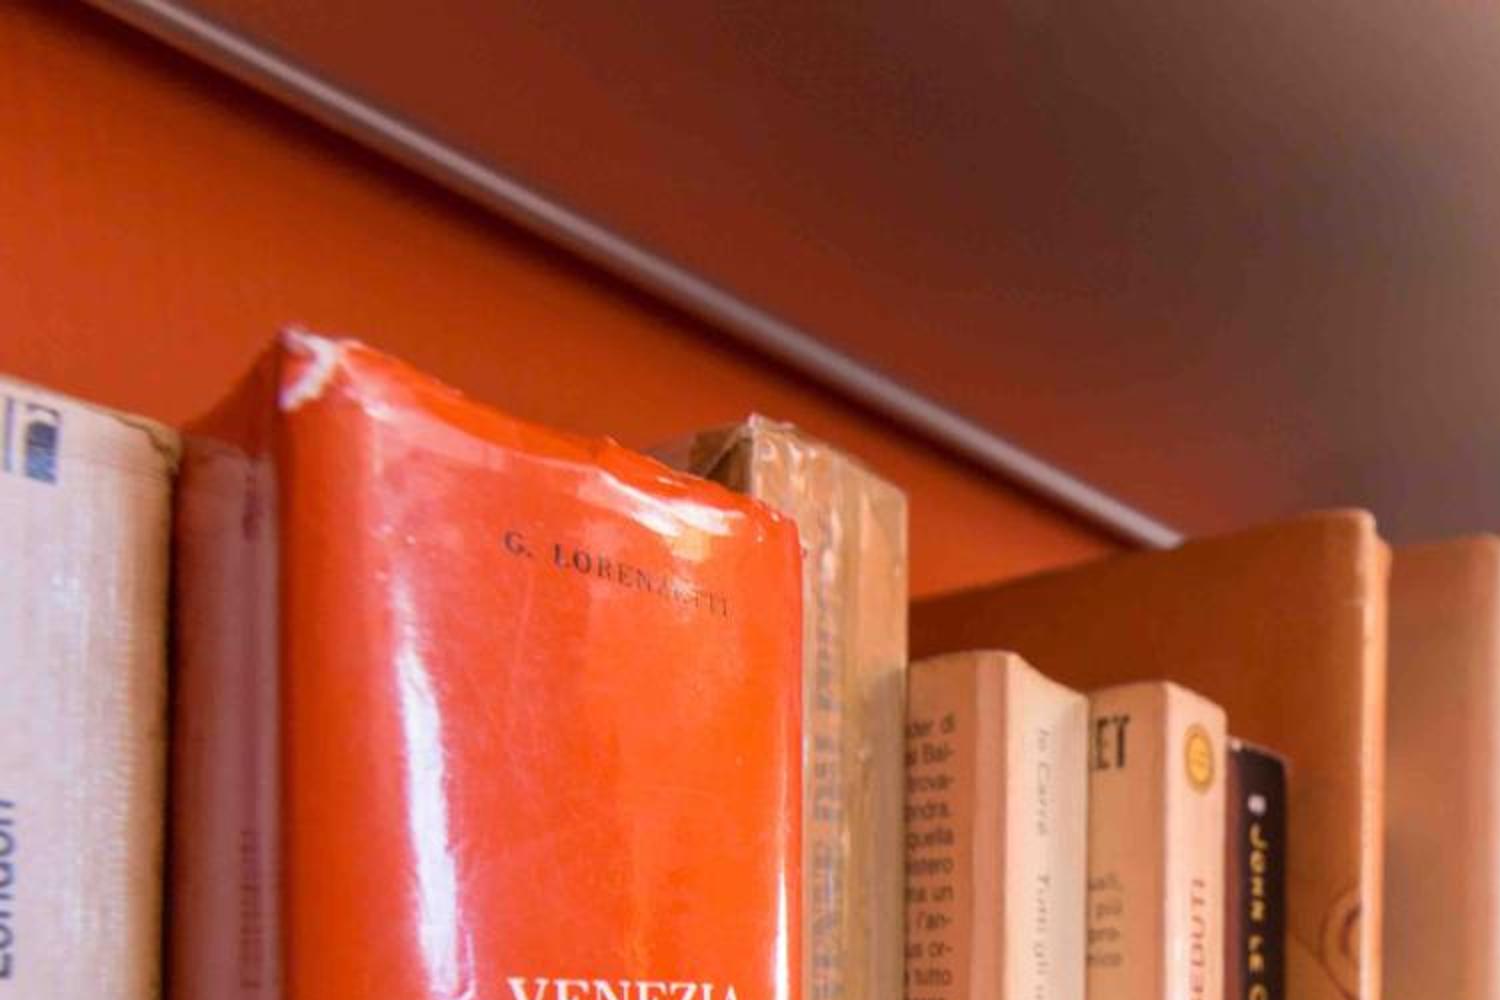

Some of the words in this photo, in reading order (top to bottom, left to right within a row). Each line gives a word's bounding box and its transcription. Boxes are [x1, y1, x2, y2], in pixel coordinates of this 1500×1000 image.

[504, 531, 532, 558] G.
[553, 543, 730, 618] LORENTTI
[1247, 821, 1269, 922] JOHN
